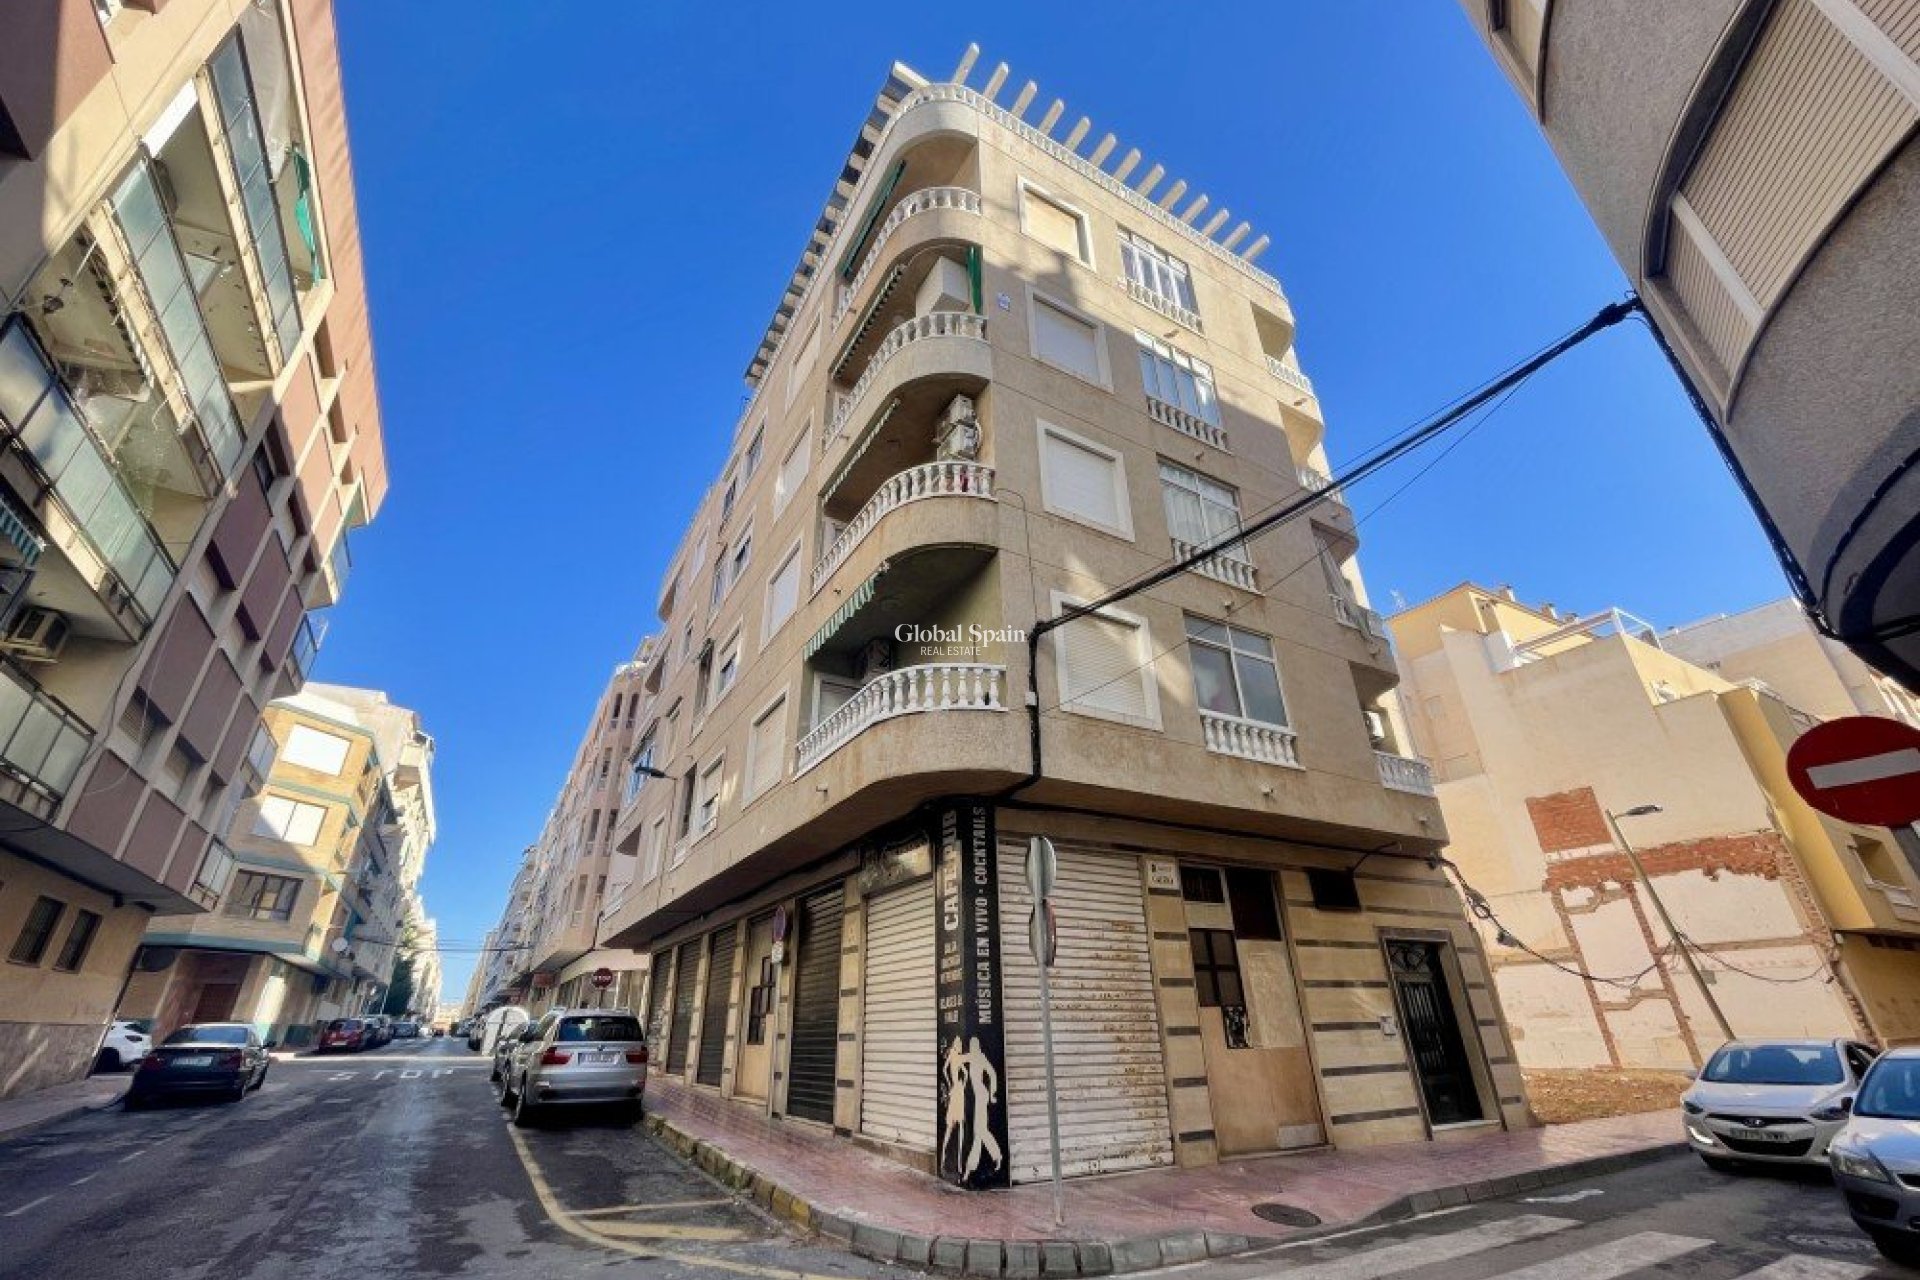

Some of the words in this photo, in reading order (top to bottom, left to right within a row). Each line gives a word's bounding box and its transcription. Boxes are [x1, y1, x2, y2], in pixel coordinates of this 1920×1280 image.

[972, 806, 988, 885] COCKTAILS
[975, 897, 989, 933] VIVO
[976, 937, 990, 958] EN
